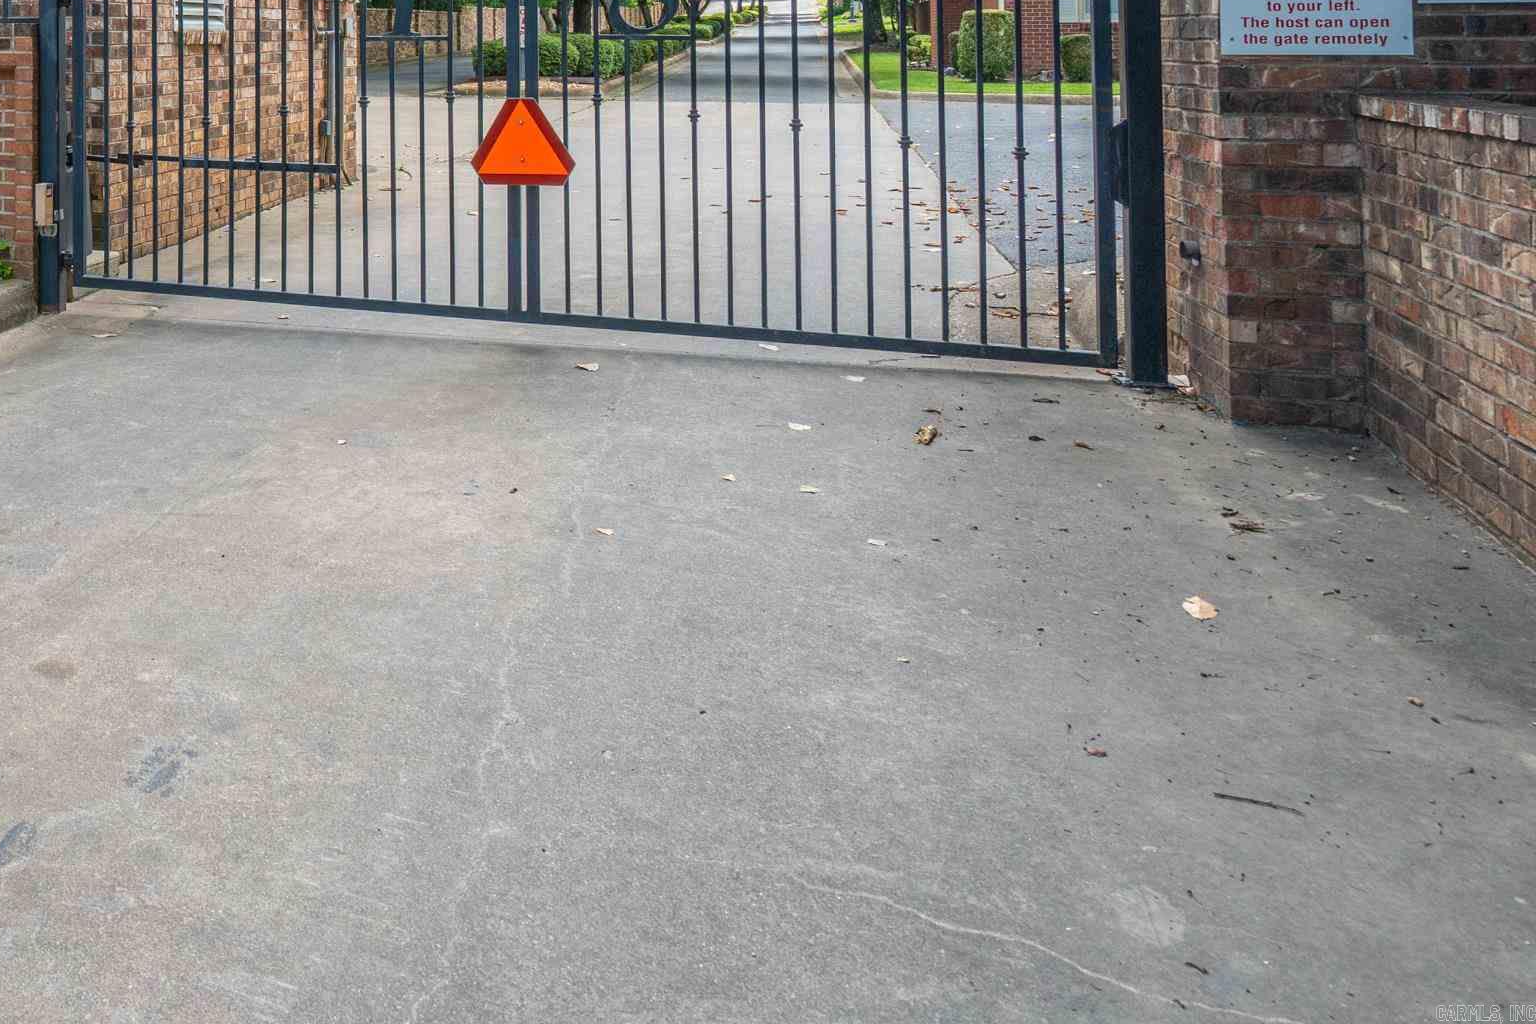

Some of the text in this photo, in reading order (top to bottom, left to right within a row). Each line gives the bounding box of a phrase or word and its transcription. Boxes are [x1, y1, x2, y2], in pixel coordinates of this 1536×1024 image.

[1267, 0, 1361, 14] to your left.
[1240, 16, 1390, 30] The host can open
[1243, 33, 1388, 46] the gate remotely
